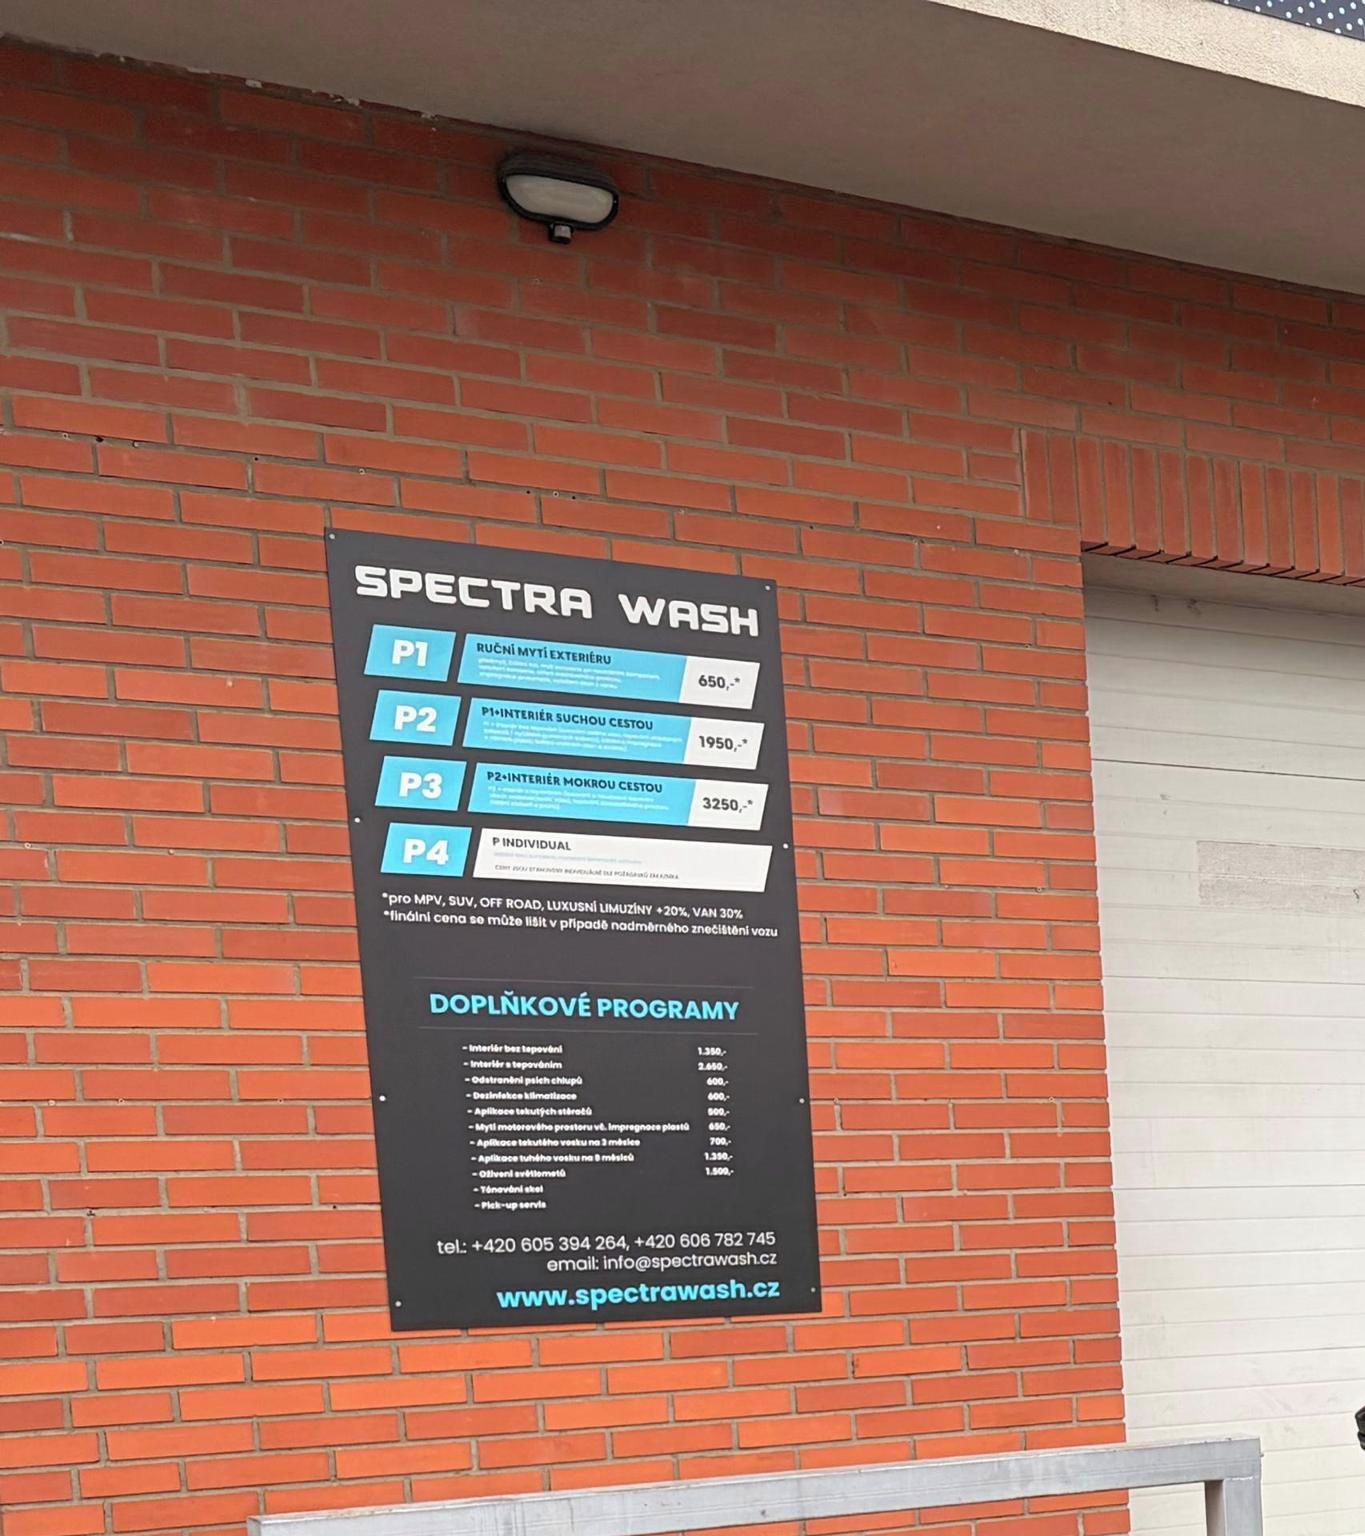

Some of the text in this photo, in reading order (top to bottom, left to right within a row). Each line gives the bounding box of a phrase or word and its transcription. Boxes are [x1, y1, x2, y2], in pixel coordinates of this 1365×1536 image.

[355, 565, 759, 637] SPECTRA WASH
[391, 639, 428, 667] P1
[476, 642, 612, 664] RUČNÍ MYTÍ EXTERIÉRU
[394, 704, 437, 733] P2
[556, 713, 606, 726] SUCHOU
[609, 717, 653, 730] CESTOU
[399, 771, 443, 799] P3
[563, 777, 616, 790] MOKROU
[618, 781, 662, 793] CESTOU
[403, 837, 449, 866] P4
[492, 837, 571, 851] P INDIVIDUAL
[414, 894, 446, 907] MPV,
[448, 895, 477, 908] SUV,
[480, 897, 503, 908] OFF
[506, 898, 545, 911] ROAD,
[547, 899, 597, 913] LUXUSNÍ
[600, 902, 652, 915] LIMUZÍNY
[656, 905, 690, 918] +20%,
[692, 907, 717, 918] VAN
[720, 908, 743, 919] 30%
[433, 914, 466, 924] cena
[469, 915, 484, 925] se
[488, 913, 522, 926] může
[525, 915, 547, 928] lišit
[550, 918, 557, 928] v
[560, 917, 608, 932] případě
[611, 919, 689, 934] nadměrného
[691, 922, 749, 936] znečištění
[751, 926, 779, 937] vozu
[430, 990, 739, 1020] DOPLŇKOVÉ PROGRAMY
[471, 1237, 516, 1253] +420
[520, 1237, 554, 1252] 605
[558, 1236, 591, 1251] 394
[595, 1235, 630, 1251] 264,
[634, 1234, 675, 1249] +420
[679, 1233, 711, 1248] 606
[714, 1232, 744, 1247] 782
[747, 1231, 776, 1246] 745
[547, 1252, 777, 1272] email: info@spectrawash.cz
[496, 1279, 780, 1311] www.spectrawash.cz
